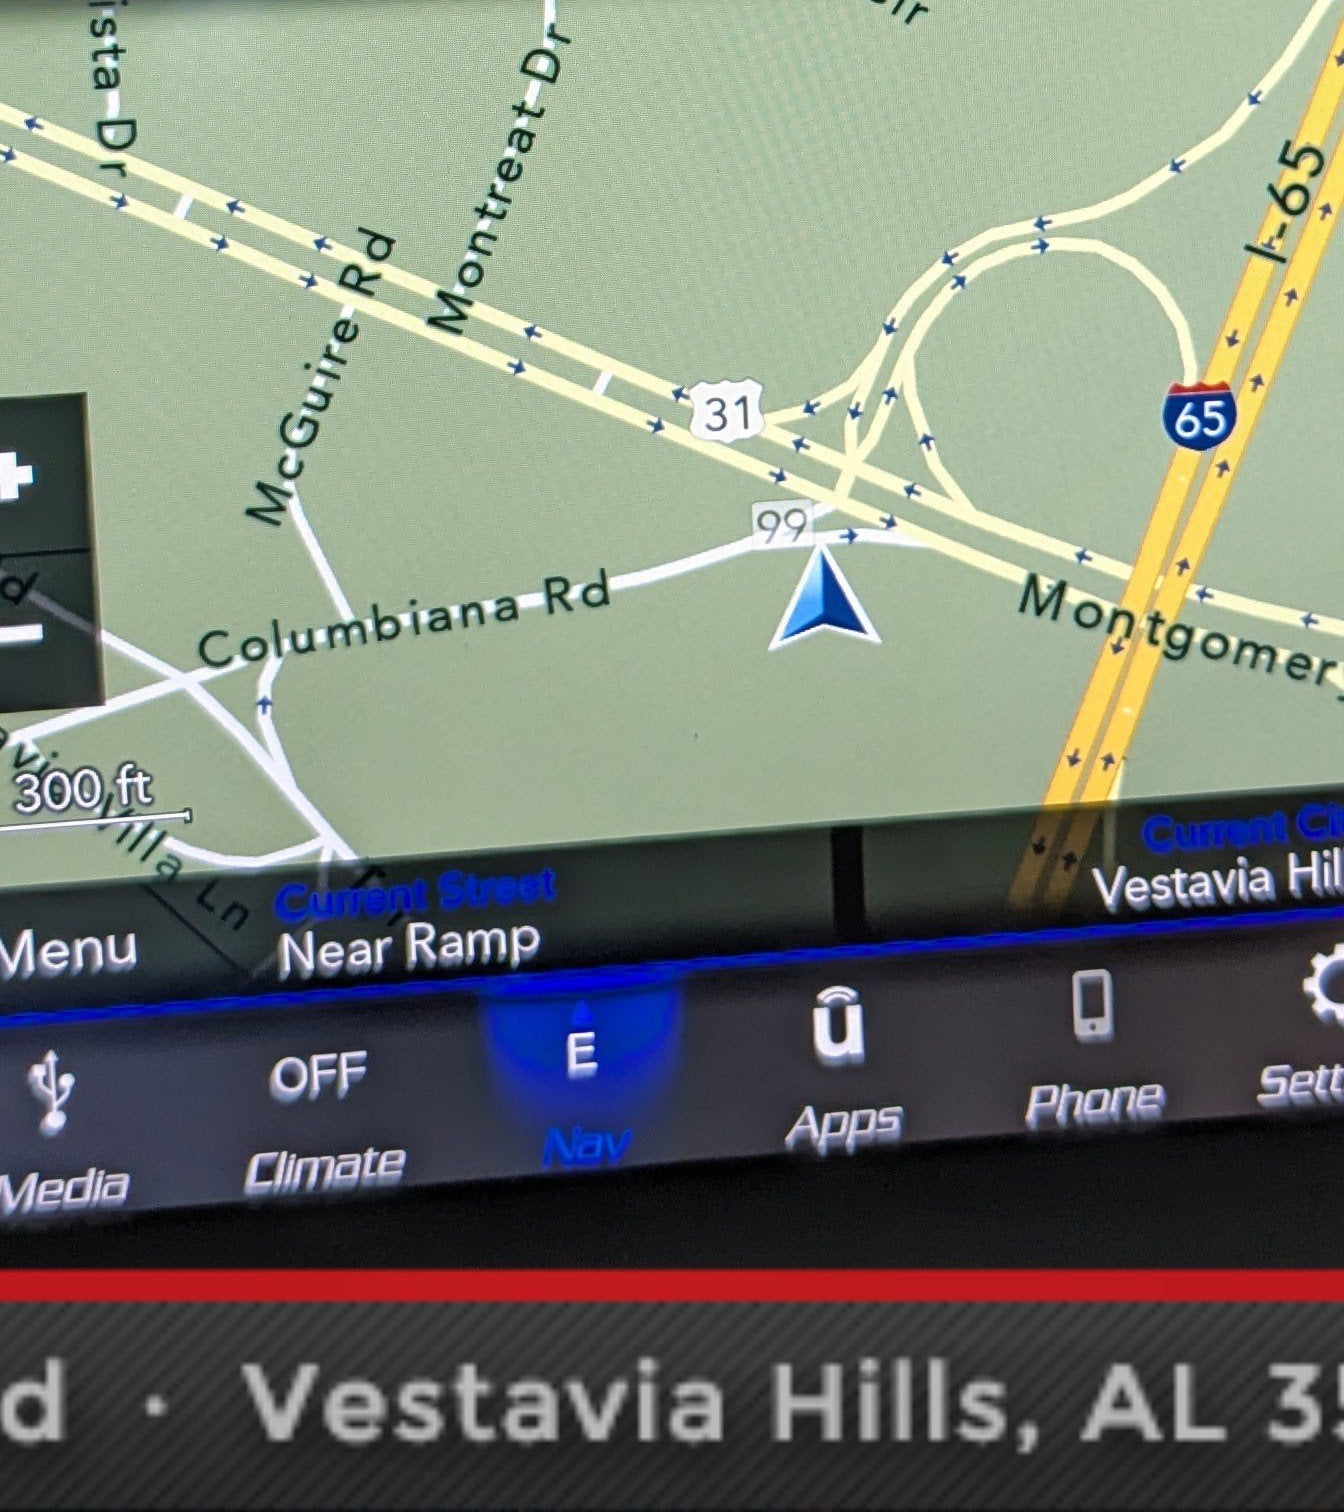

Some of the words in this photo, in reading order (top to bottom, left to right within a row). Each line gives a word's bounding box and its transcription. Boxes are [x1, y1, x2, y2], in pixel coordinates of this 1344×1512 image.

[96, 118, 138, 178] Dr
[427, 98, 545, 336] Montreat
[521, 21, 573, 86] Dr
[1243, 138, 1326, 265] I-65
[245, 318, 361, 527] McGuire
[338, 226, 398, 298] Rd
[704, 396, 754, 433] 31
[1173, 401, 1228, 437] 65
[756, 507, 809, 542] 99
[197, 587, 521, 670] Columbiana
[543, 568, 612, 614] Rd
[13, 767, 103, 815] 300
[115, 760, 155, 807] ft
[1142, 810, 1287, 855] Current
[195, 877, 250, 931] Ln
[272, 879, 430, 925] Current
[435, 867, 557, 913] Street
[1092, 862, 1273, 914] Vestavia
[276, 929, 394, 983] Near
[405, 920, 542, 972] Ramp
[269, 1050, 368, 1105] OFF
[567, 1031, 599, 1080] E
[784, 1101, 904, 1156] Apps
[1025, 1079, 1166, 1131] Phone
[243, 1144, 408, 1197] Climate
[541, 1125, 634, 1172] Nav
